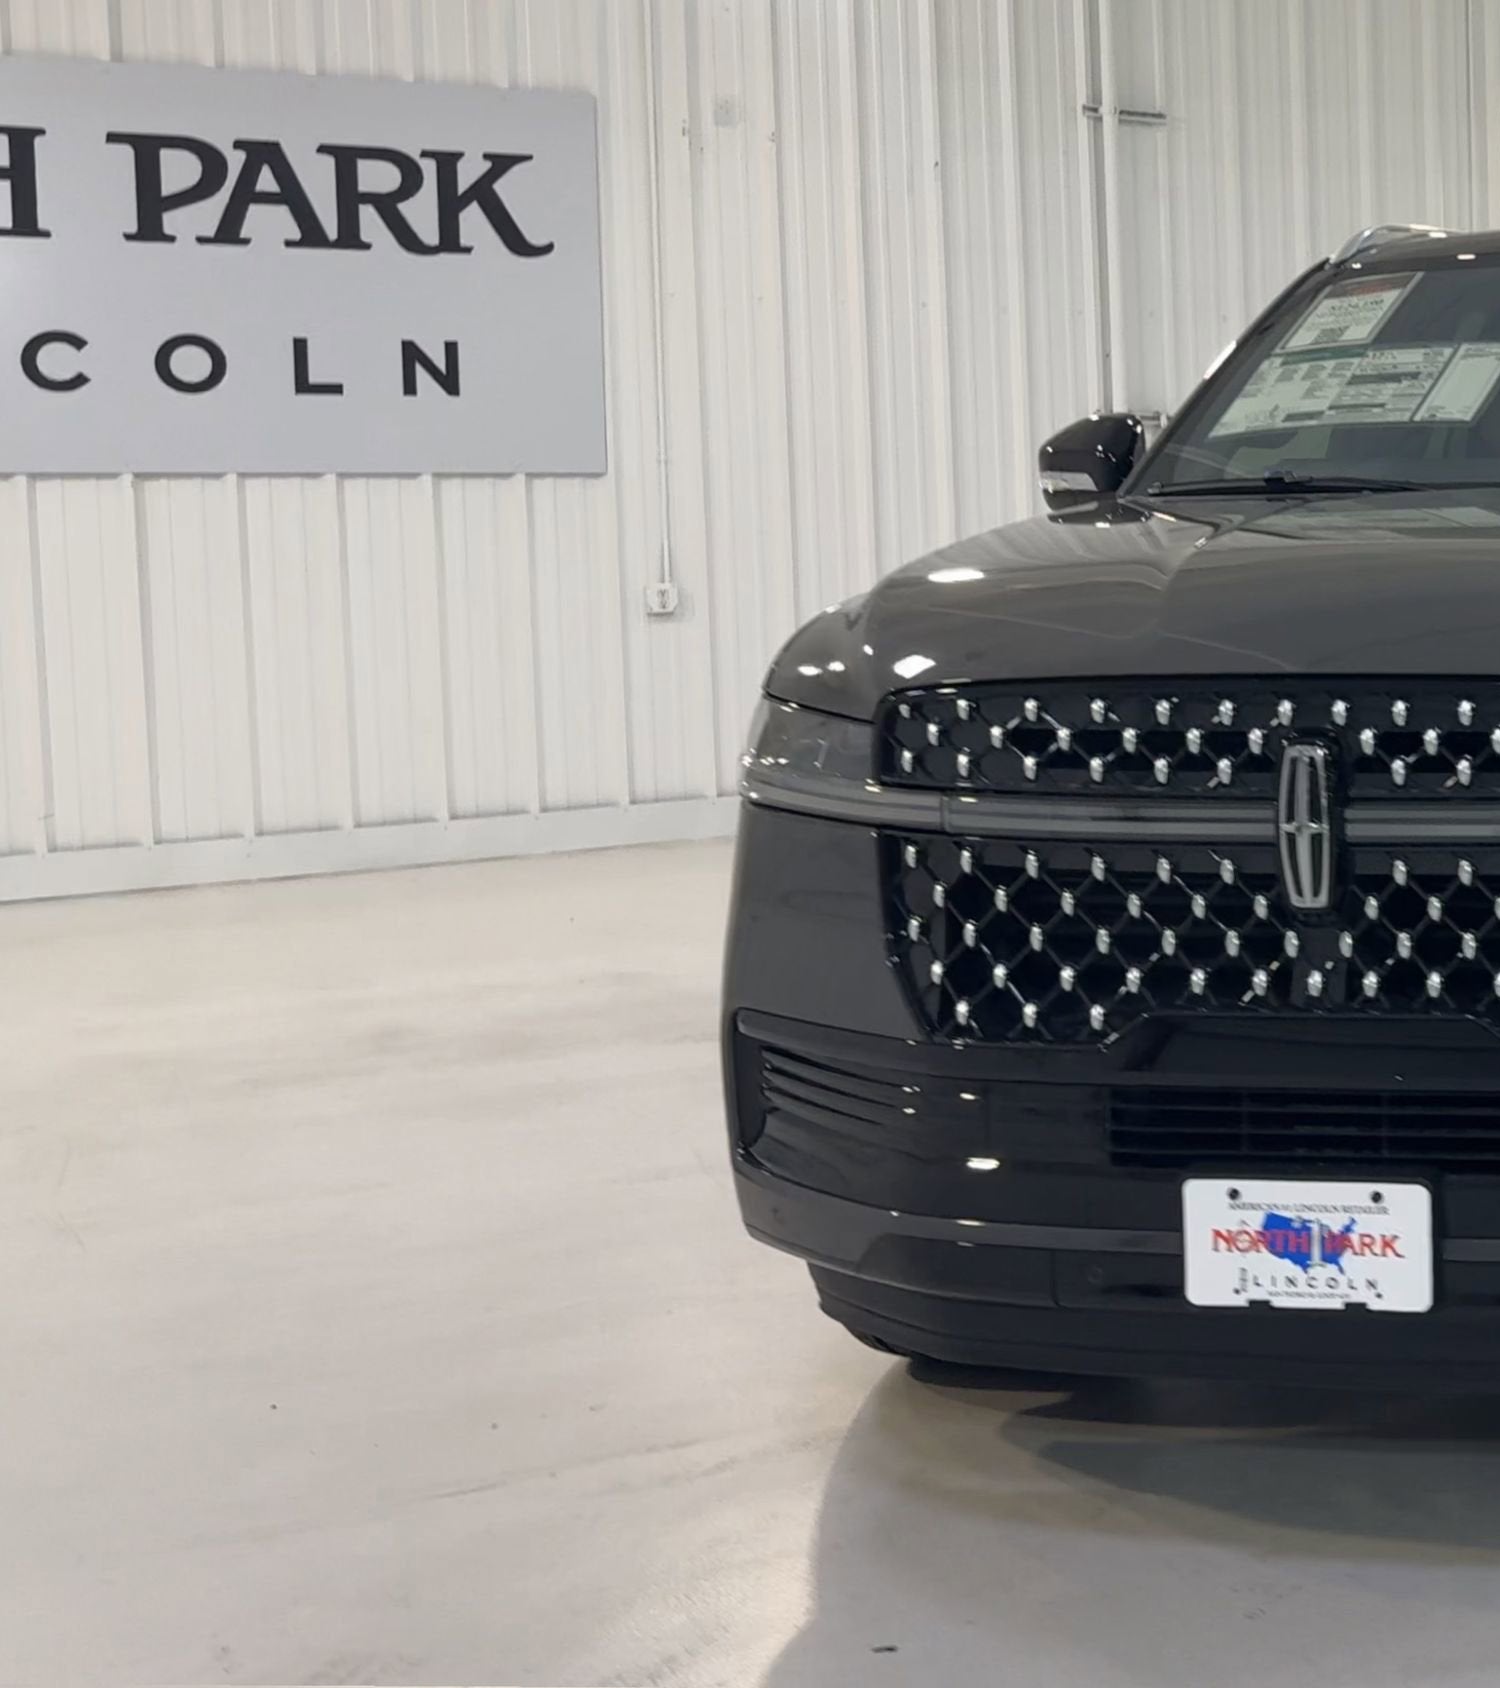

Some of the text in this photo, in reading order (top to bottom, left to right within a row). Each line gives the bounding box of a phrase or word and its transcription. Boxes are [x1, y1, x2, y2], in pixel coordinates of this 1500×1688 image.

[106, 132, 554, 257] PARK
[21, 330, 460, 397] COLN
[1211, 1229, 1405, 1259] NORTH PARK
[1253, 1274, 1378, 1292] LINCOLN
